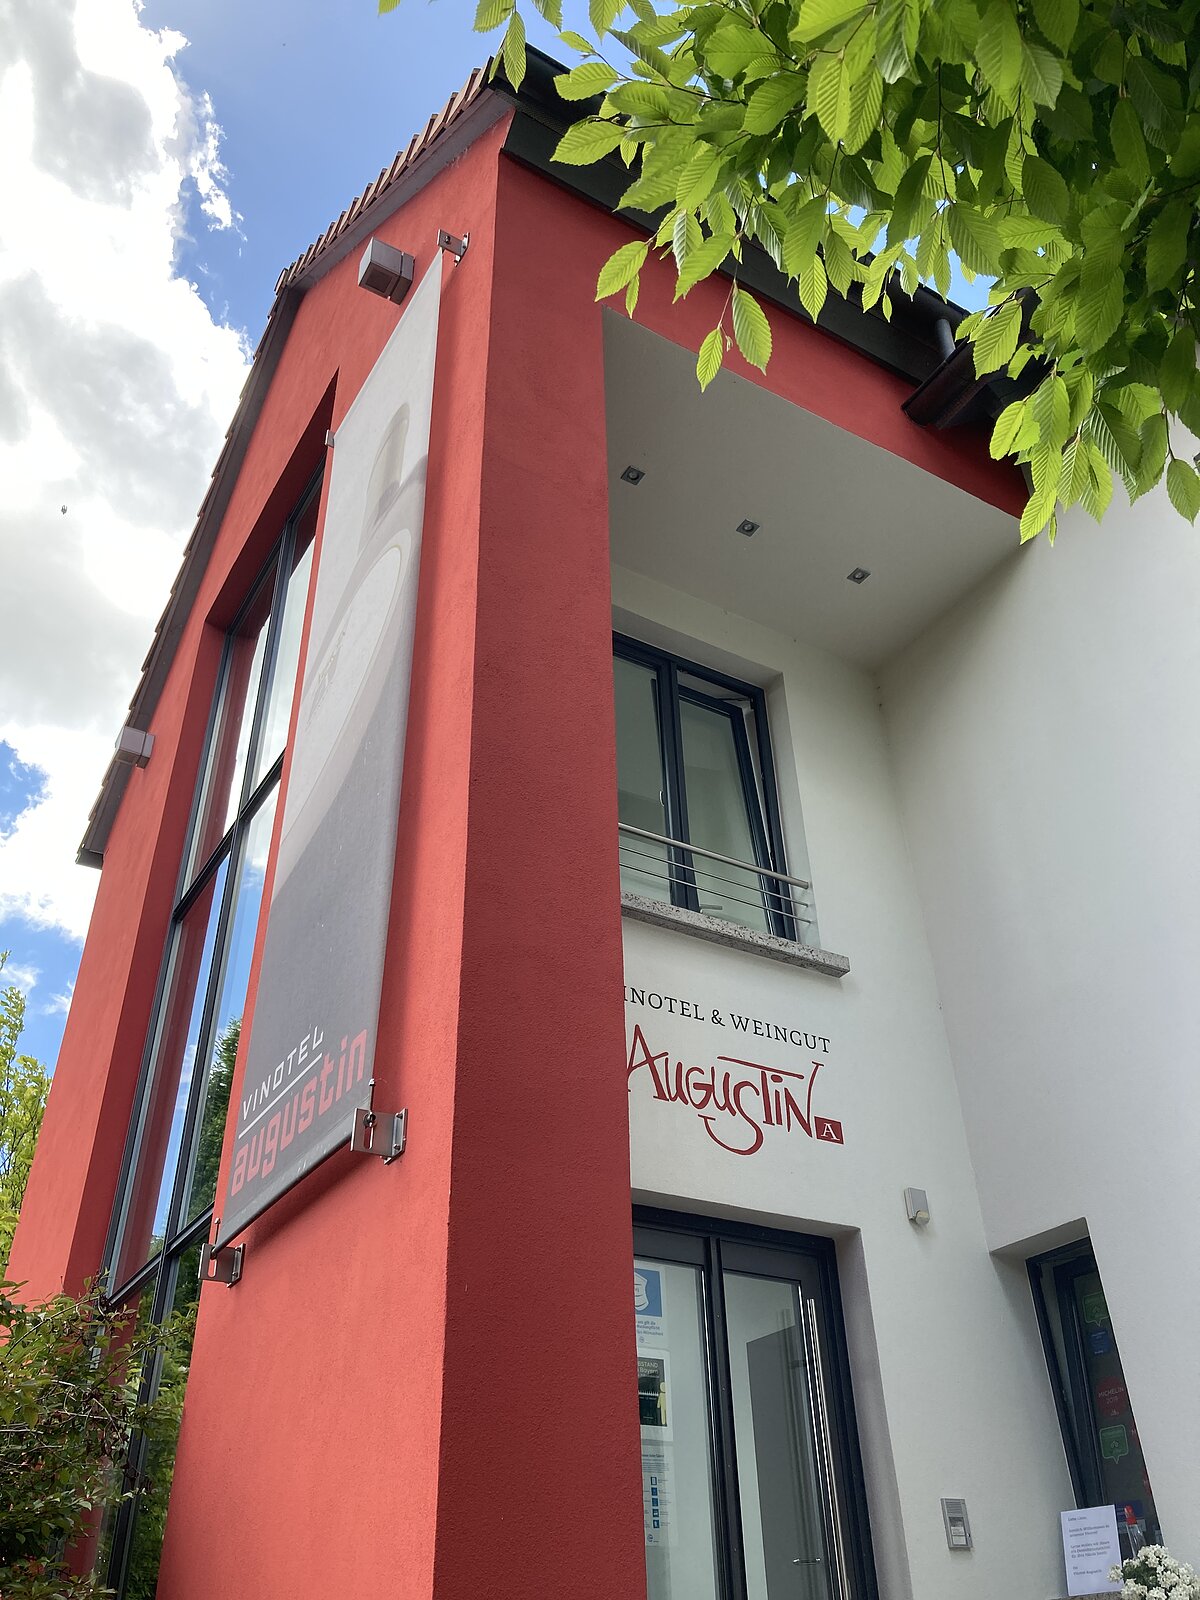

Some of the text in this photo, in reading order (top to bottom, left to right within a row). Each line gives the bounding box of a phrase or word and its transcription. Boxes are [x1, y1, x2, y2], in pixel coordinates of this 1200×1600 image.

[623, 985, 831, 1054] INOTEL & WEINGUT
[230, 1028, 368, 1197] augustin
[243, 1025, 324, 1121] VINOTEL
[1098, 1387, 1124, 1398] MICHELIN
